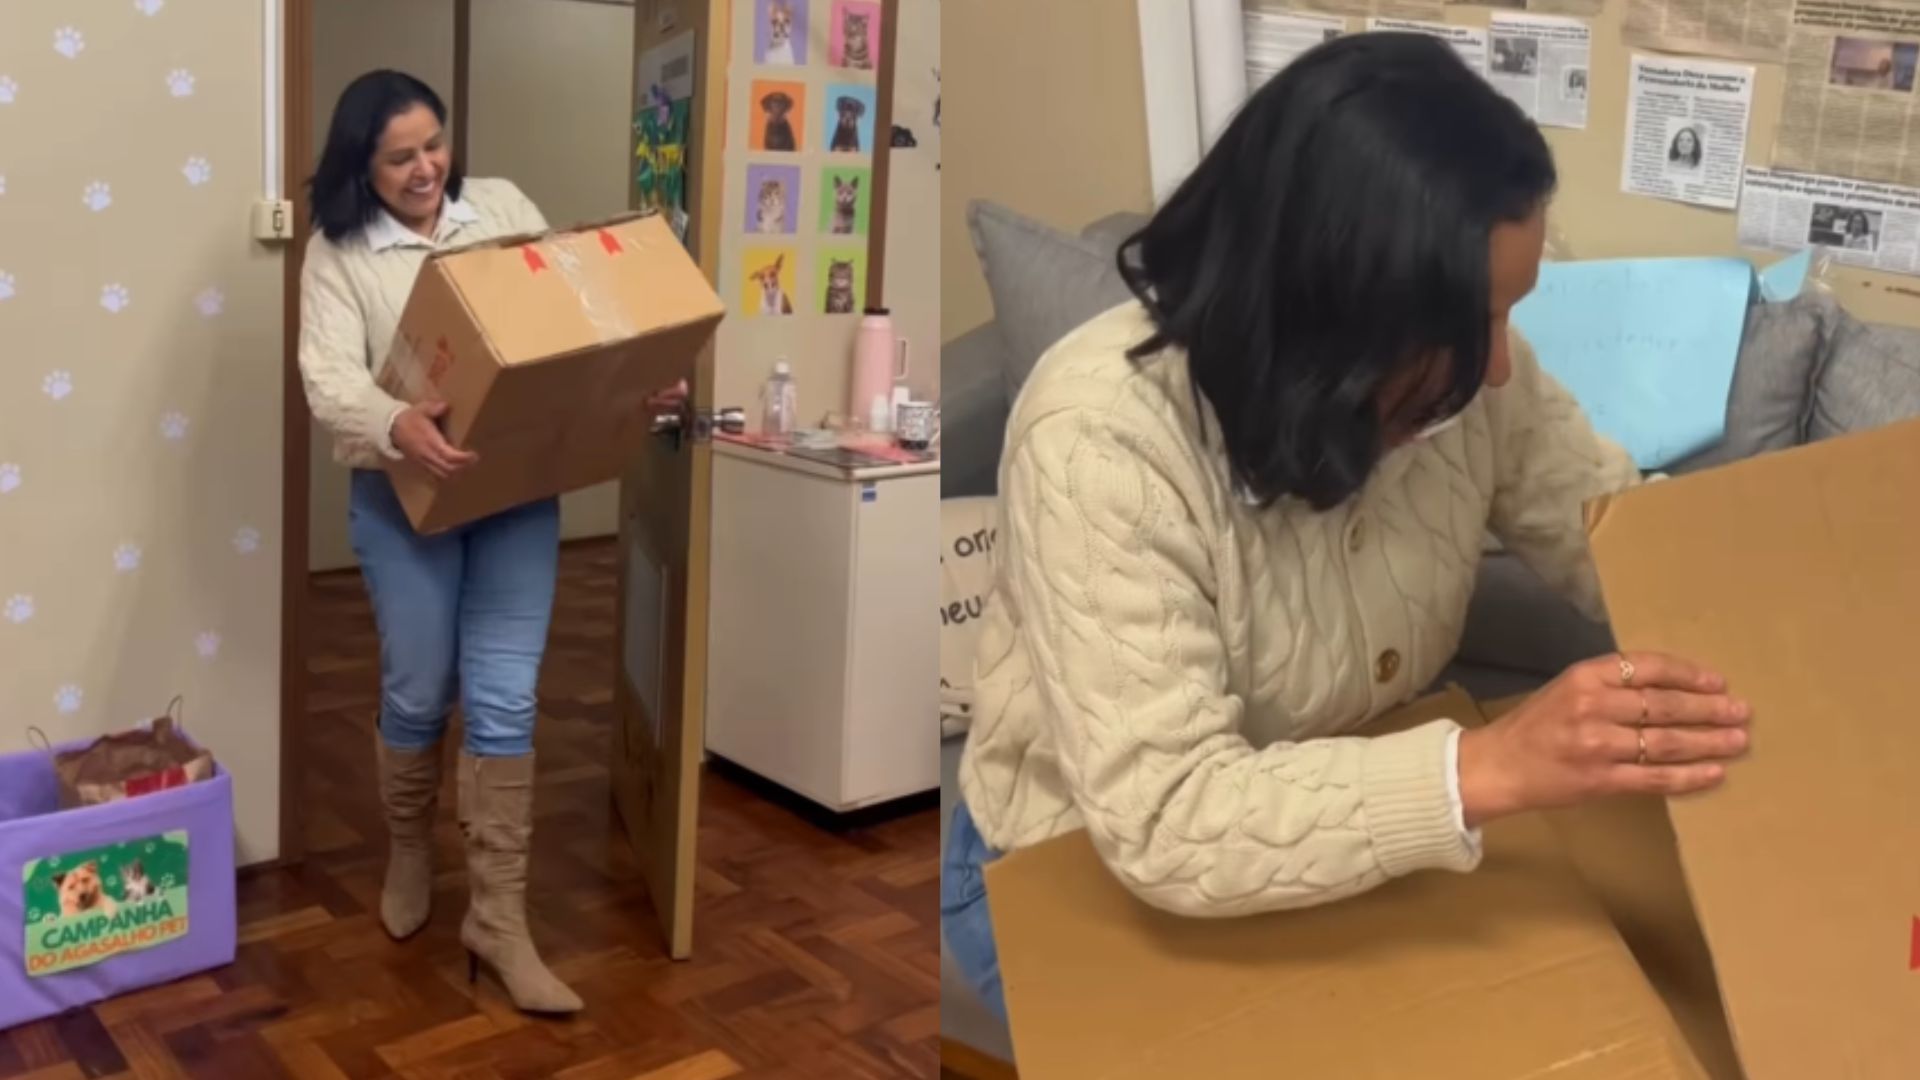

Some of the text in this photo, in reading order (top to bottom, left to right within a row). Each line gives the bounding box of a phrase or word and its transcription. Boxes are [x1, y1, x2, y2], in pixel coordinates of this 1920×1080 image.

[29, 916, 187, 972] DO AGASALHO PET
[41, 899, 174, 949] CAMPANHA
